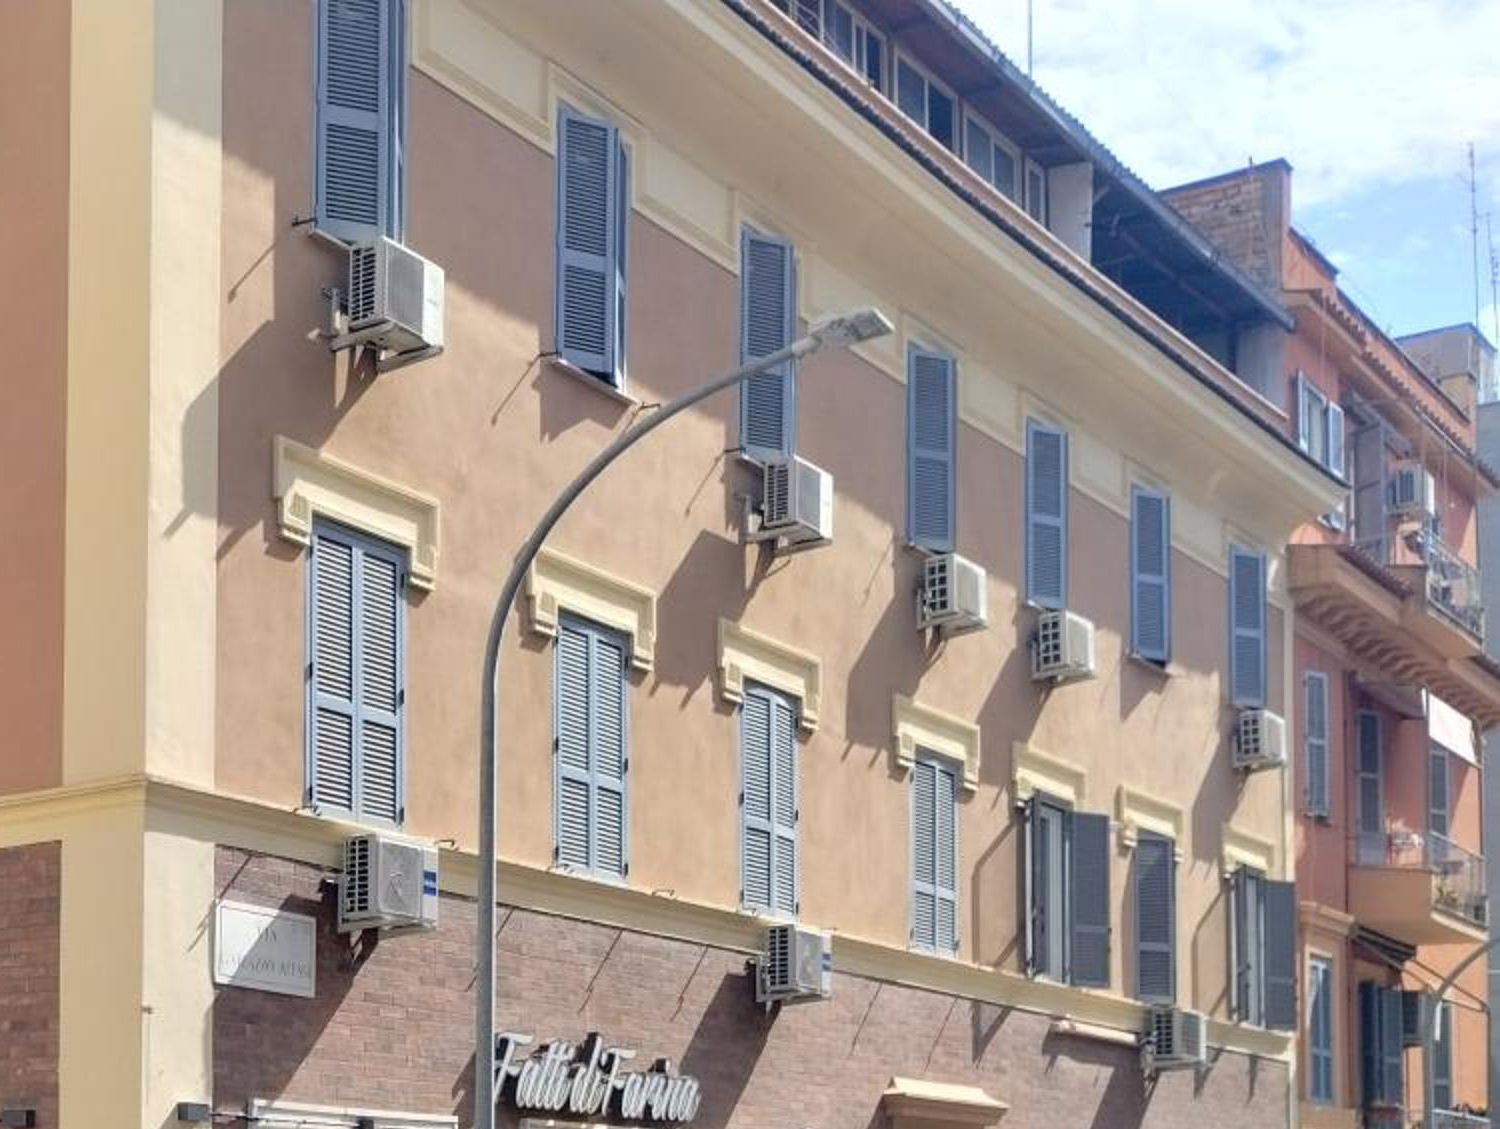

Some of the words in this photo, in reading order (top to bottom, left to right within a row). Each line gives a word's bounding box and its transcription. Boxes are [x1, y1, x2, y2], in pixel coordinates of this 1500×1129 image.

[494, 1031, 575, 1110] Fatti
[569, 1035, 606, 1115] di
[600, 1046, 702, 1122] Farina
